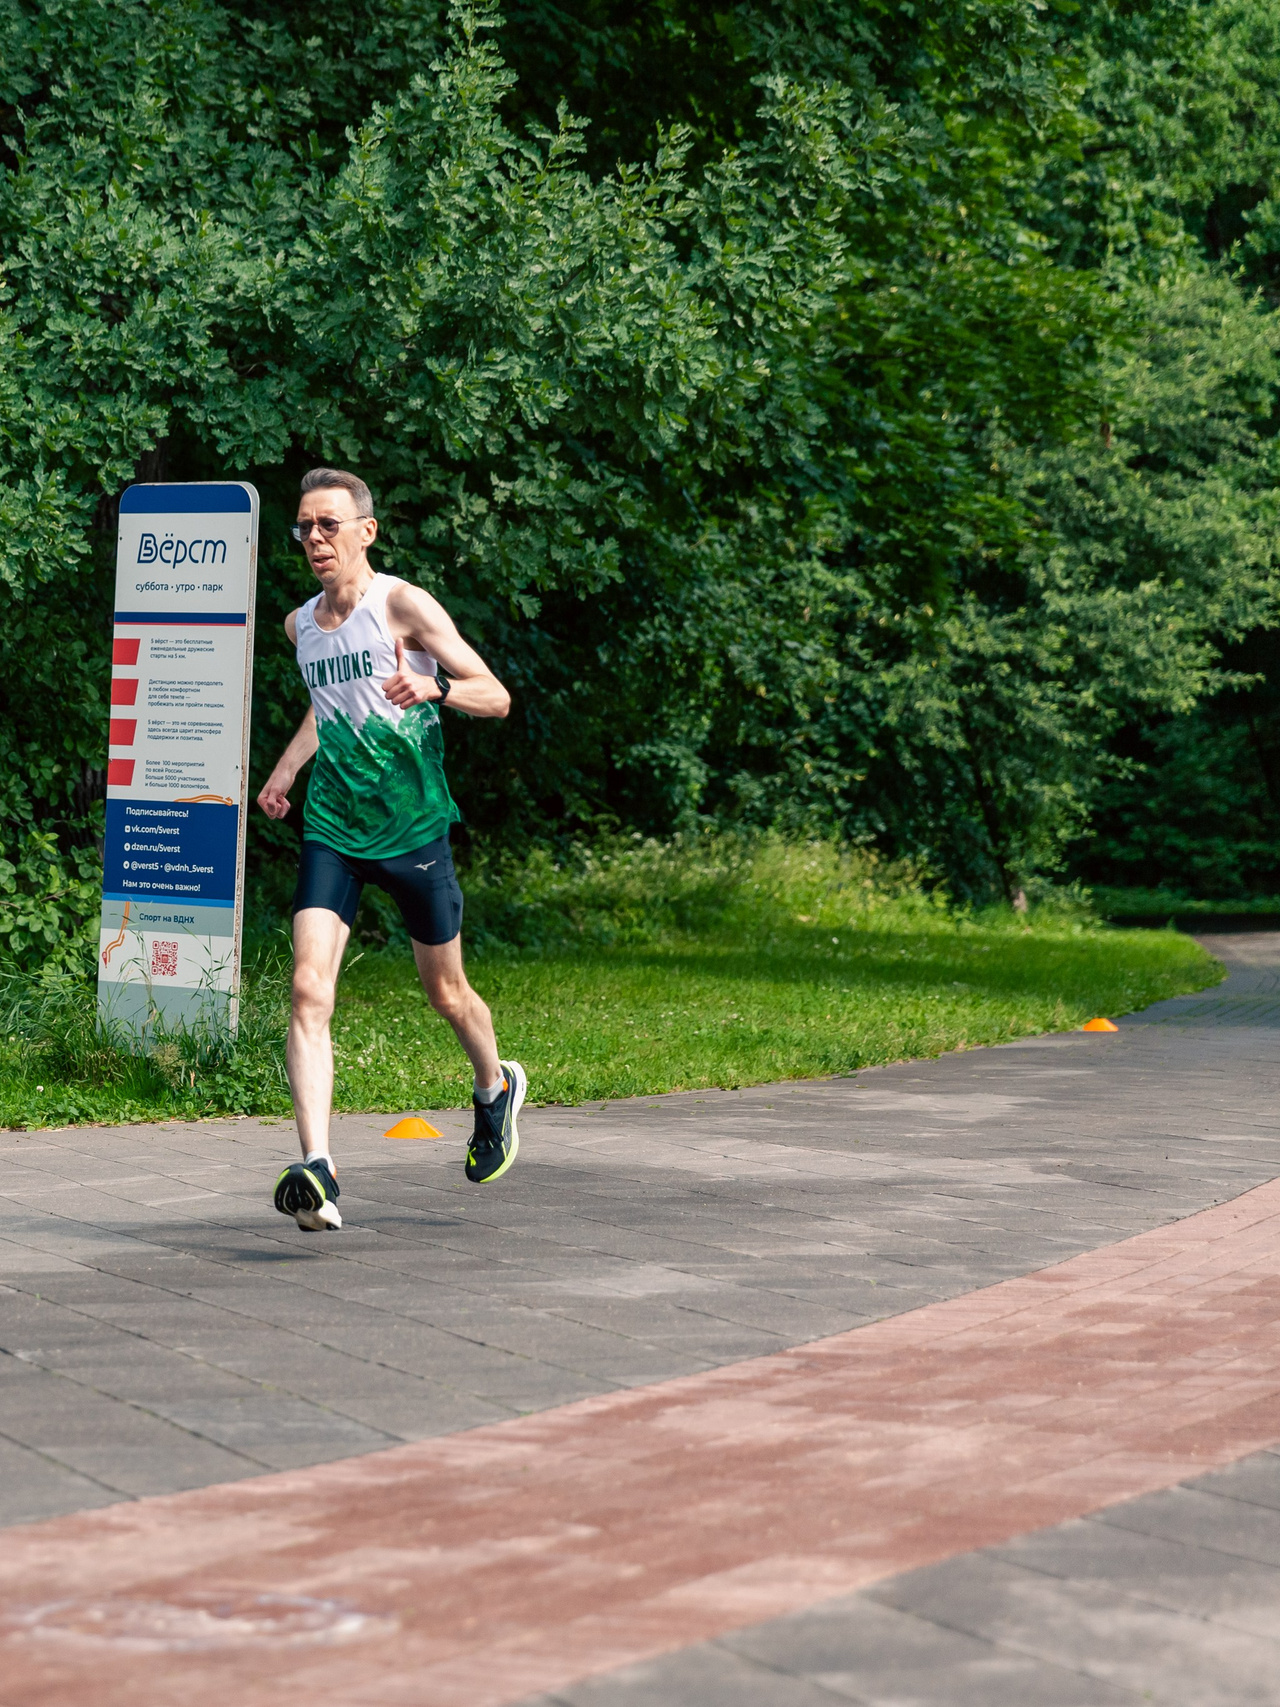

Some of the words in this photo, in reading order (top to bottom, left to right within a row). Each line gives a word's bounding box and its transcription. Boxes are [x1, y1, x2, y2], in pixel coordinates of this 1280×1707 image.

[136, 582, 168, 592] суббота
[176, 584, 196, 592] утро
[202, 584, 223, 592] парк
[126, 807, 188, 817] Подписывайтесь!
[132, 825, 180, 834] vk.com/5verst
[132, 842, 180, 853] dzen.ru/5verst
[131, 861, 159, 870] @verst5
[164, 863, 214, 873] @vdnh_5verst
[123, 880, 137, 888] Нам
[140, 913, 161, 923] Спорт
